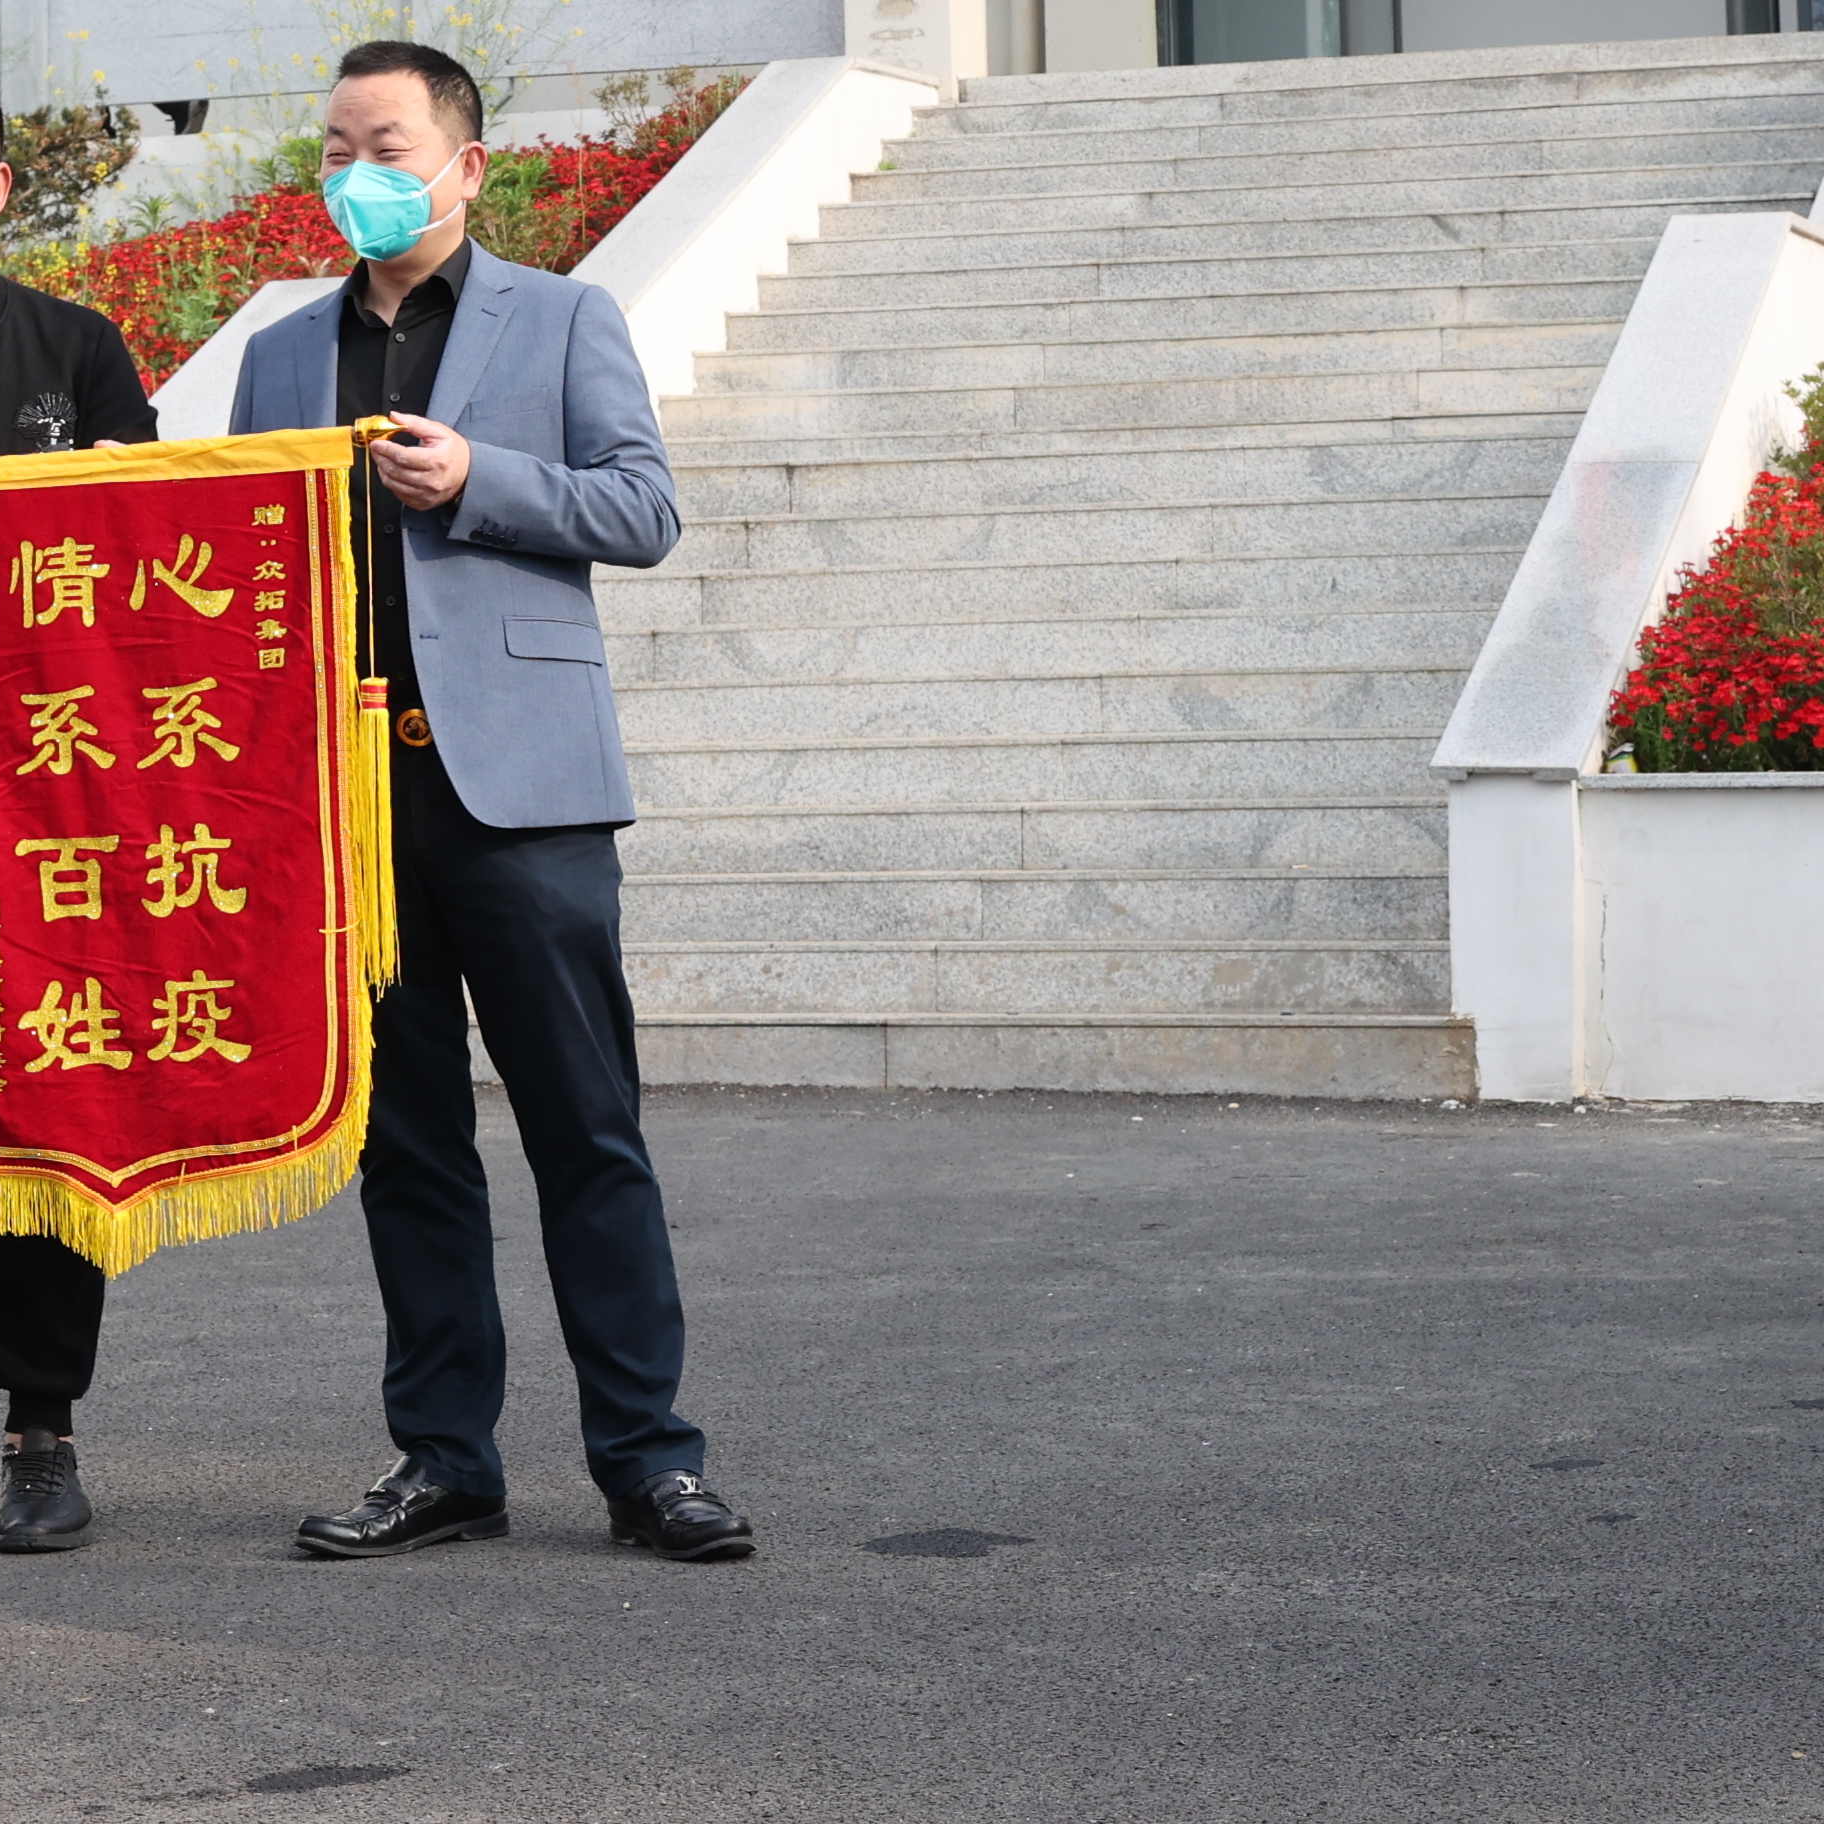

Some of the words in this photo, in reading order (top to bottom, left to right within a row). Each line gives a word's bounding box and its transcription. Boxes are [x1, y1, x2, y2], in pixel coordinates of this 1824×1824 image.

[10, 537, 134, 1074] 情系百姓
[129, 535, 252, 1064] 心系抗疫
